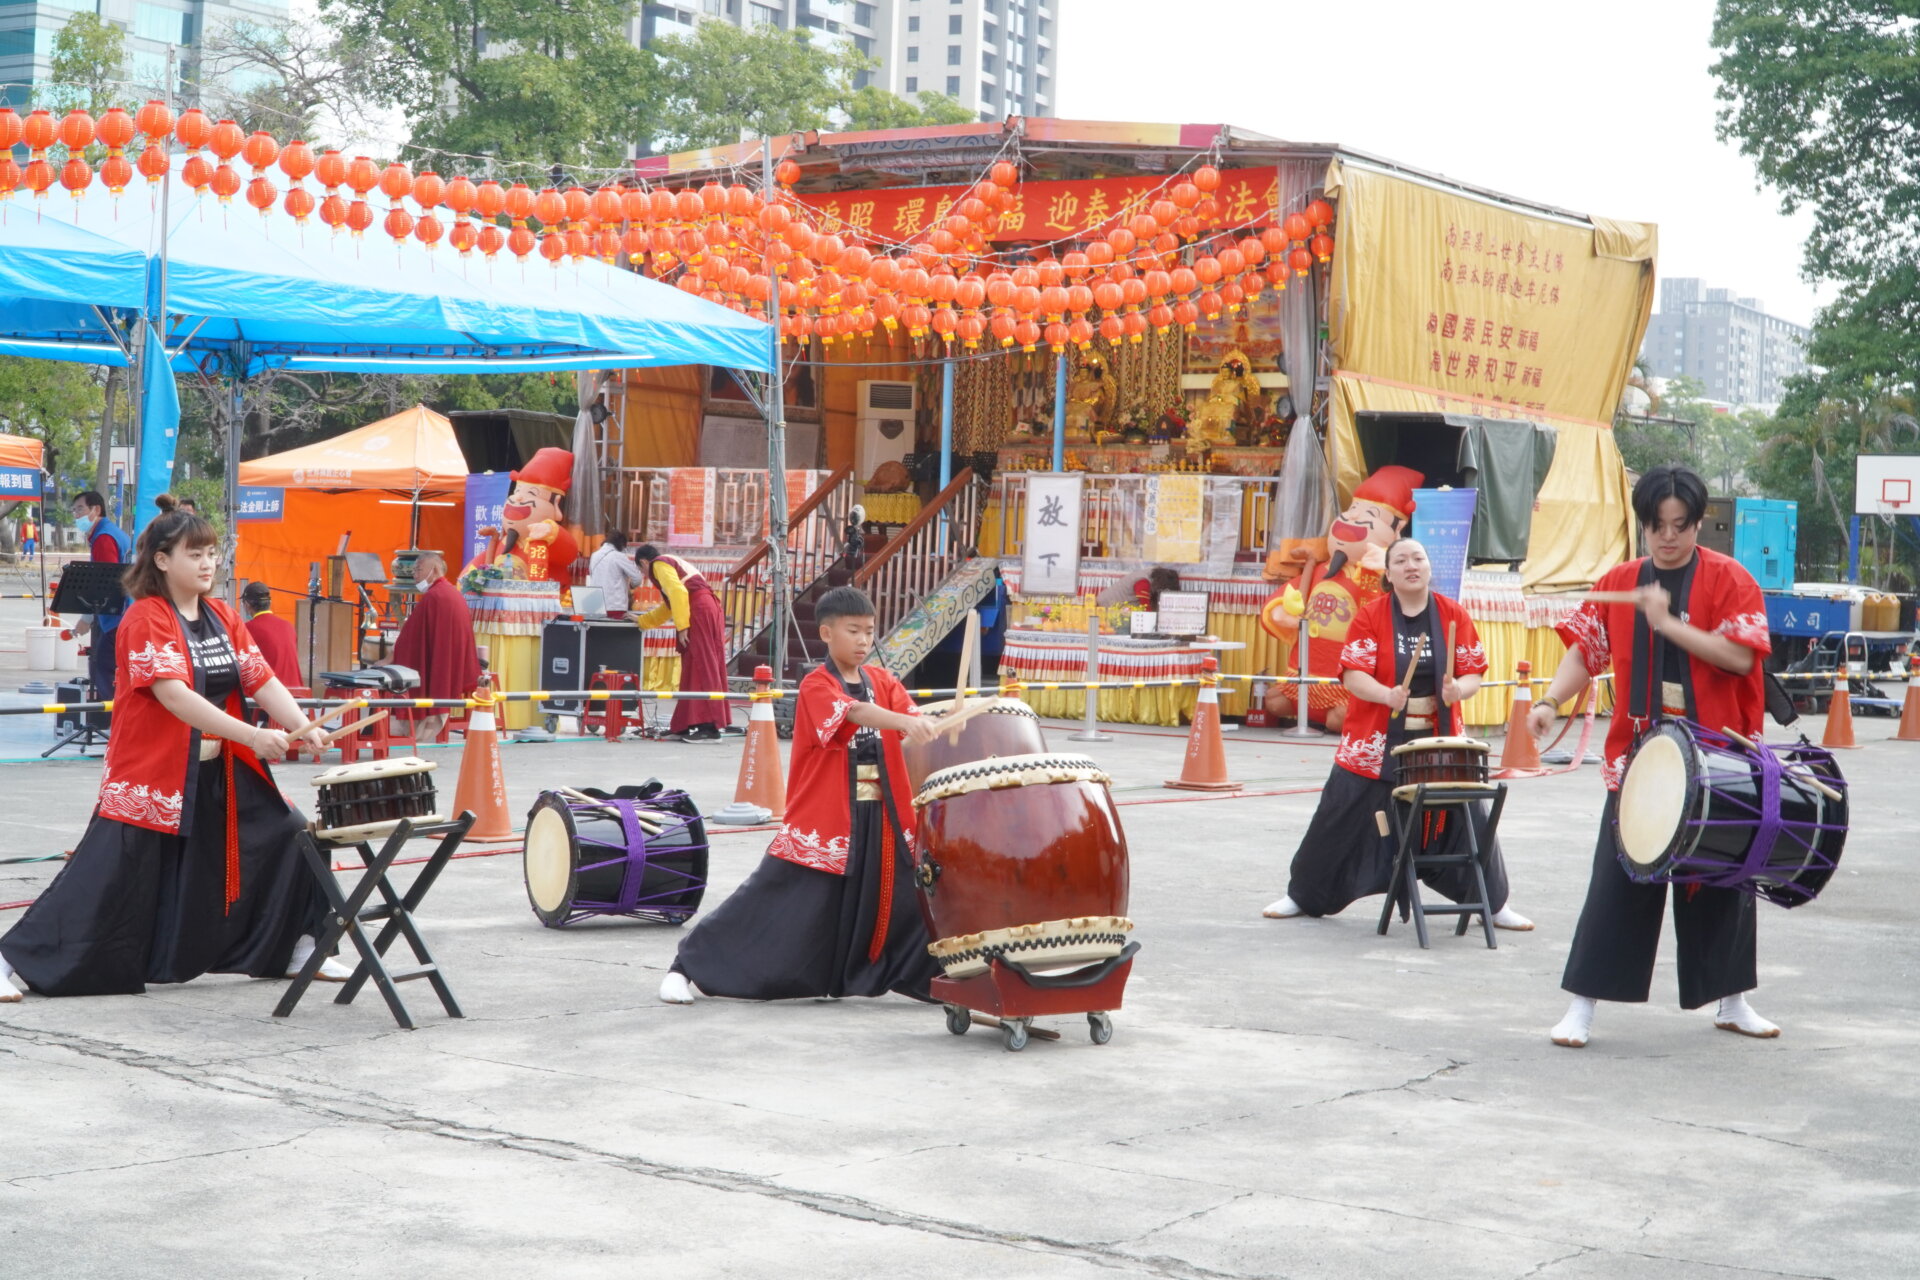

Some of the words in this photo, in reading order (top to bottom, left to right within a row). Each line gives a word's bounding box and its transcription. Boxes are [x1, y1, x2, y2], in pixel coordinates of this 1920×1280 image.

[893, 193, 1026, 237] 環島福
[1045, 176, 1279, 232] 迎春祈法會
[237, 500, 280, 513] 法金剛上師
[1037, 495, 1068, 578] 放下
[1783, 611, 1821, 630] 公司
[204, 654, 233, 667] AIWAN
